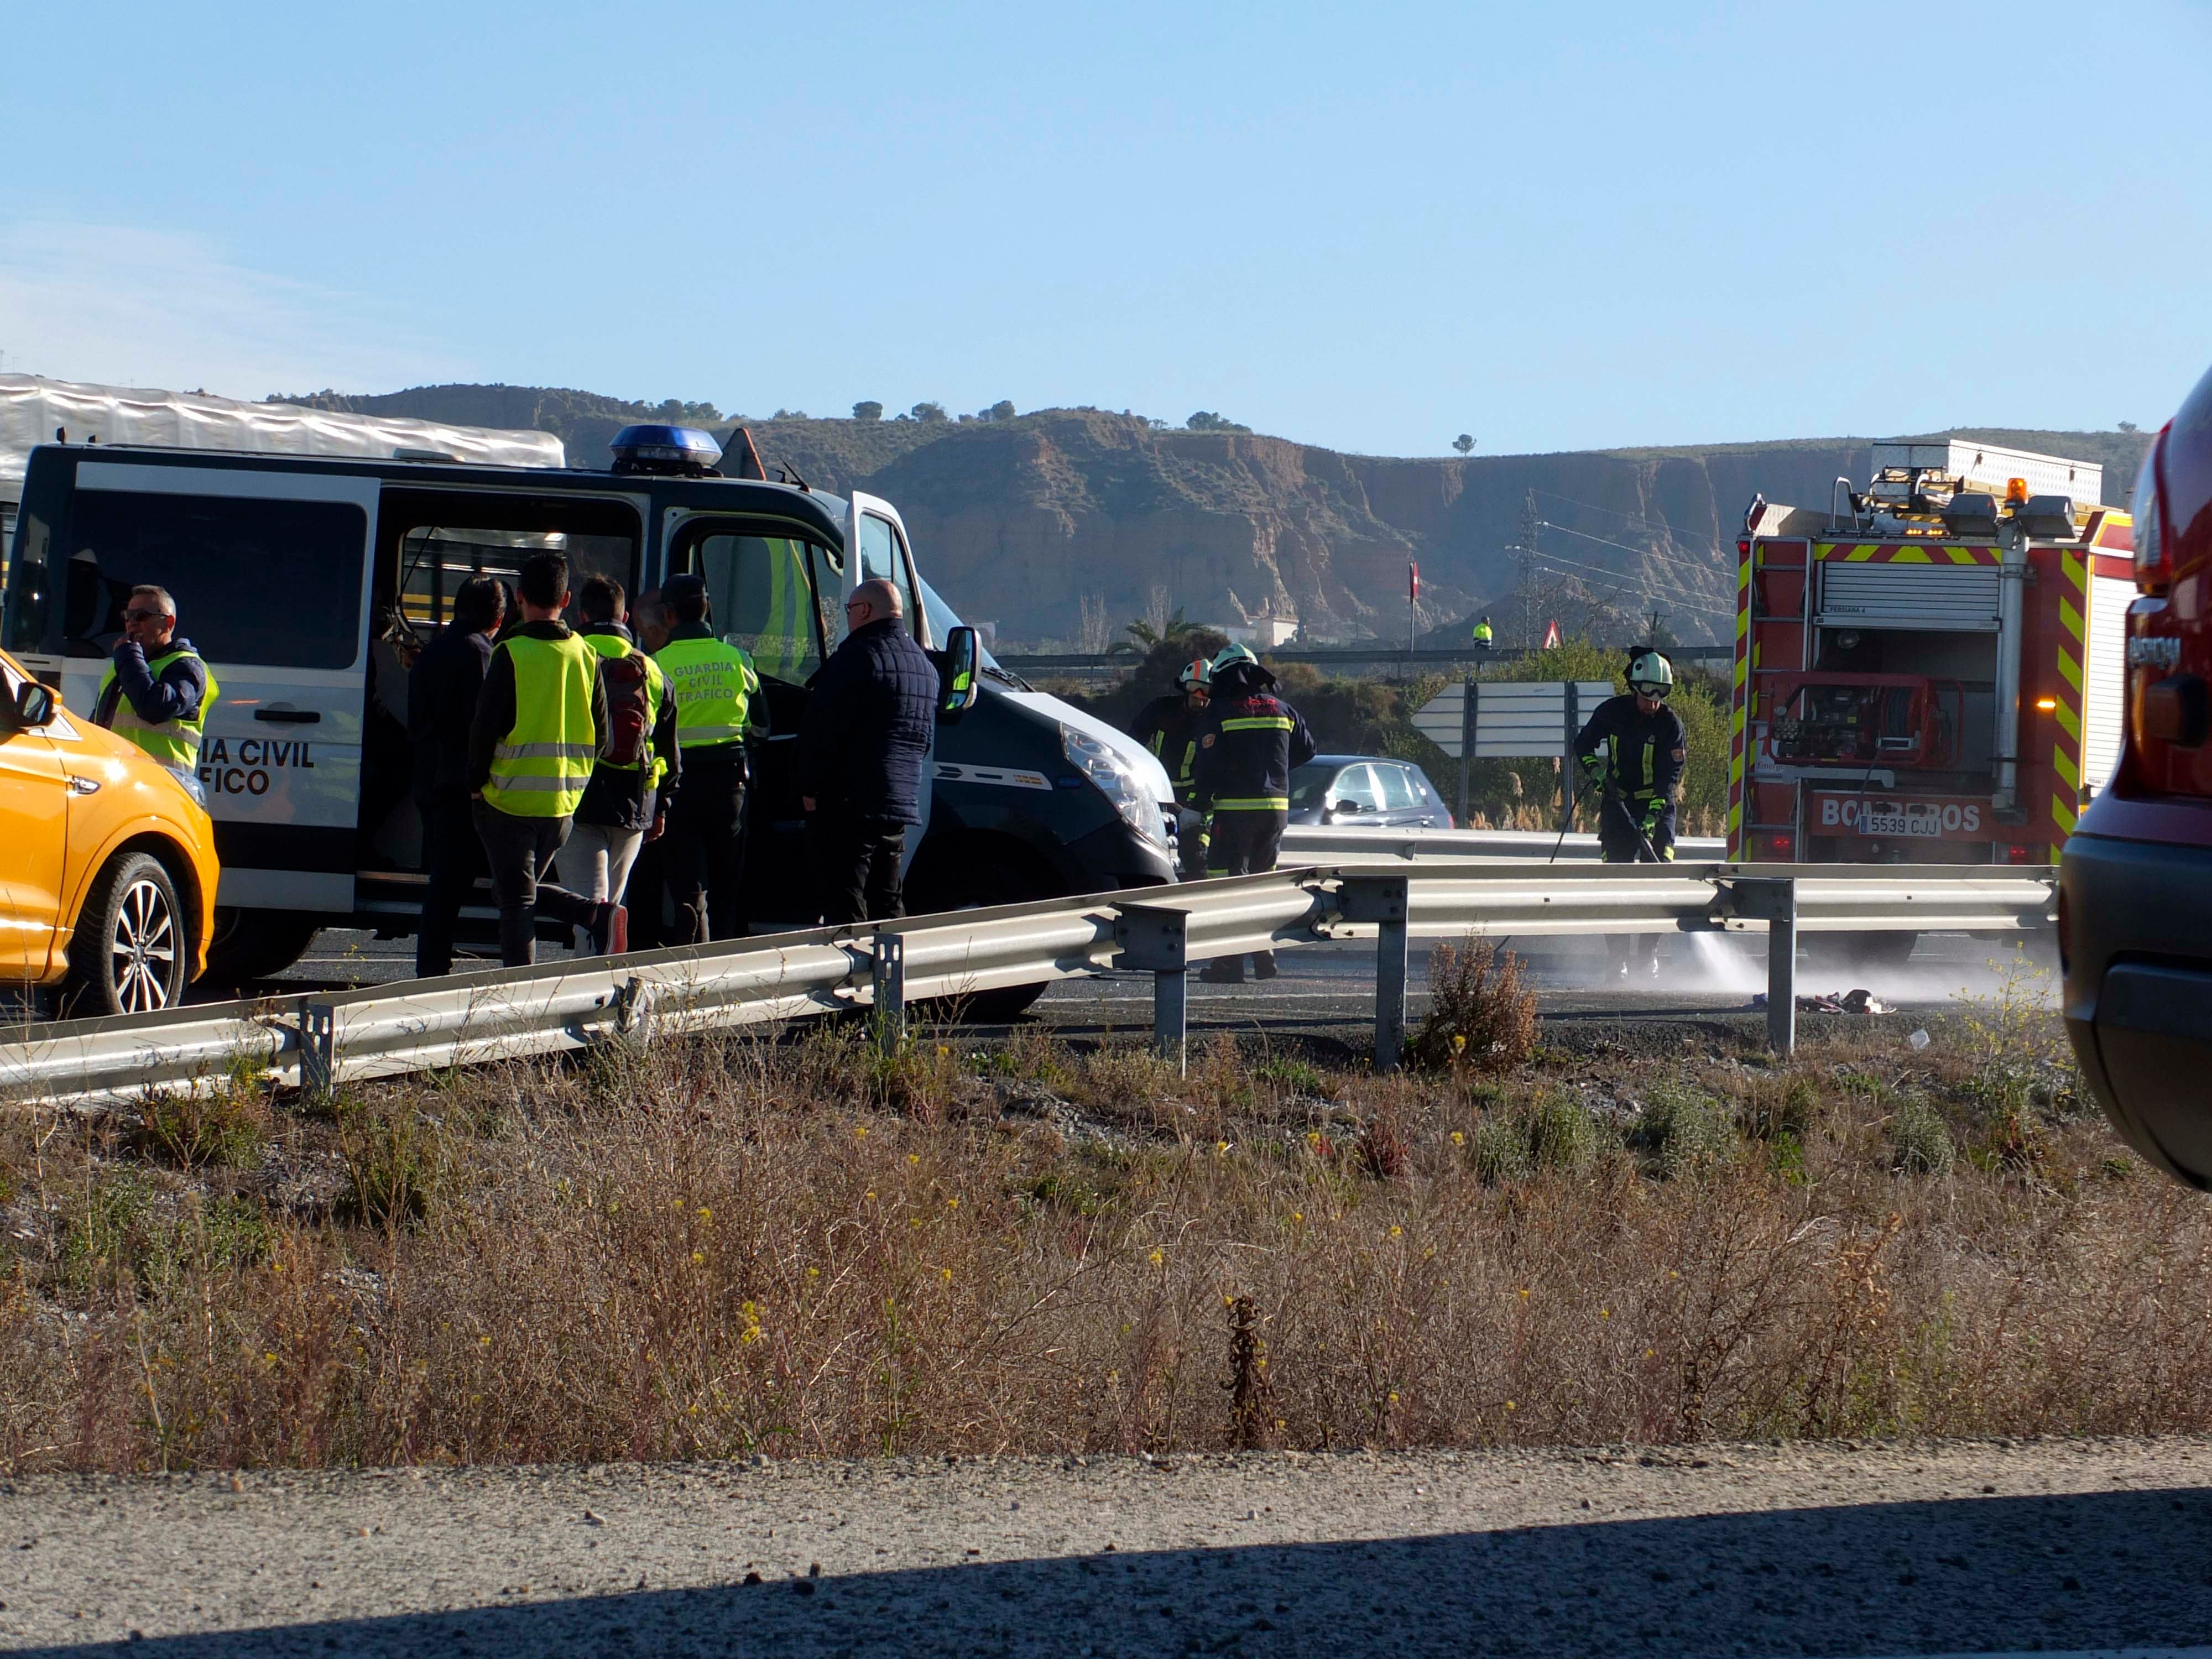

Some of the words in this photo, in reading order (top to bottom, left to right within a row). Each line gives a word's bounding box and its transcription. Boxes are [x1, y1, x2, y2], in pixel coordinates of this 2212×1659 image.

[674, 662, 734, 676] GUARDIA
[690, 675, 723, 687] CIVIL
[239, 740, 315, 768] CIVIL
[1871, 817, 1906, 833] 5539
[1911, 820, 1937, 835] CJJ
